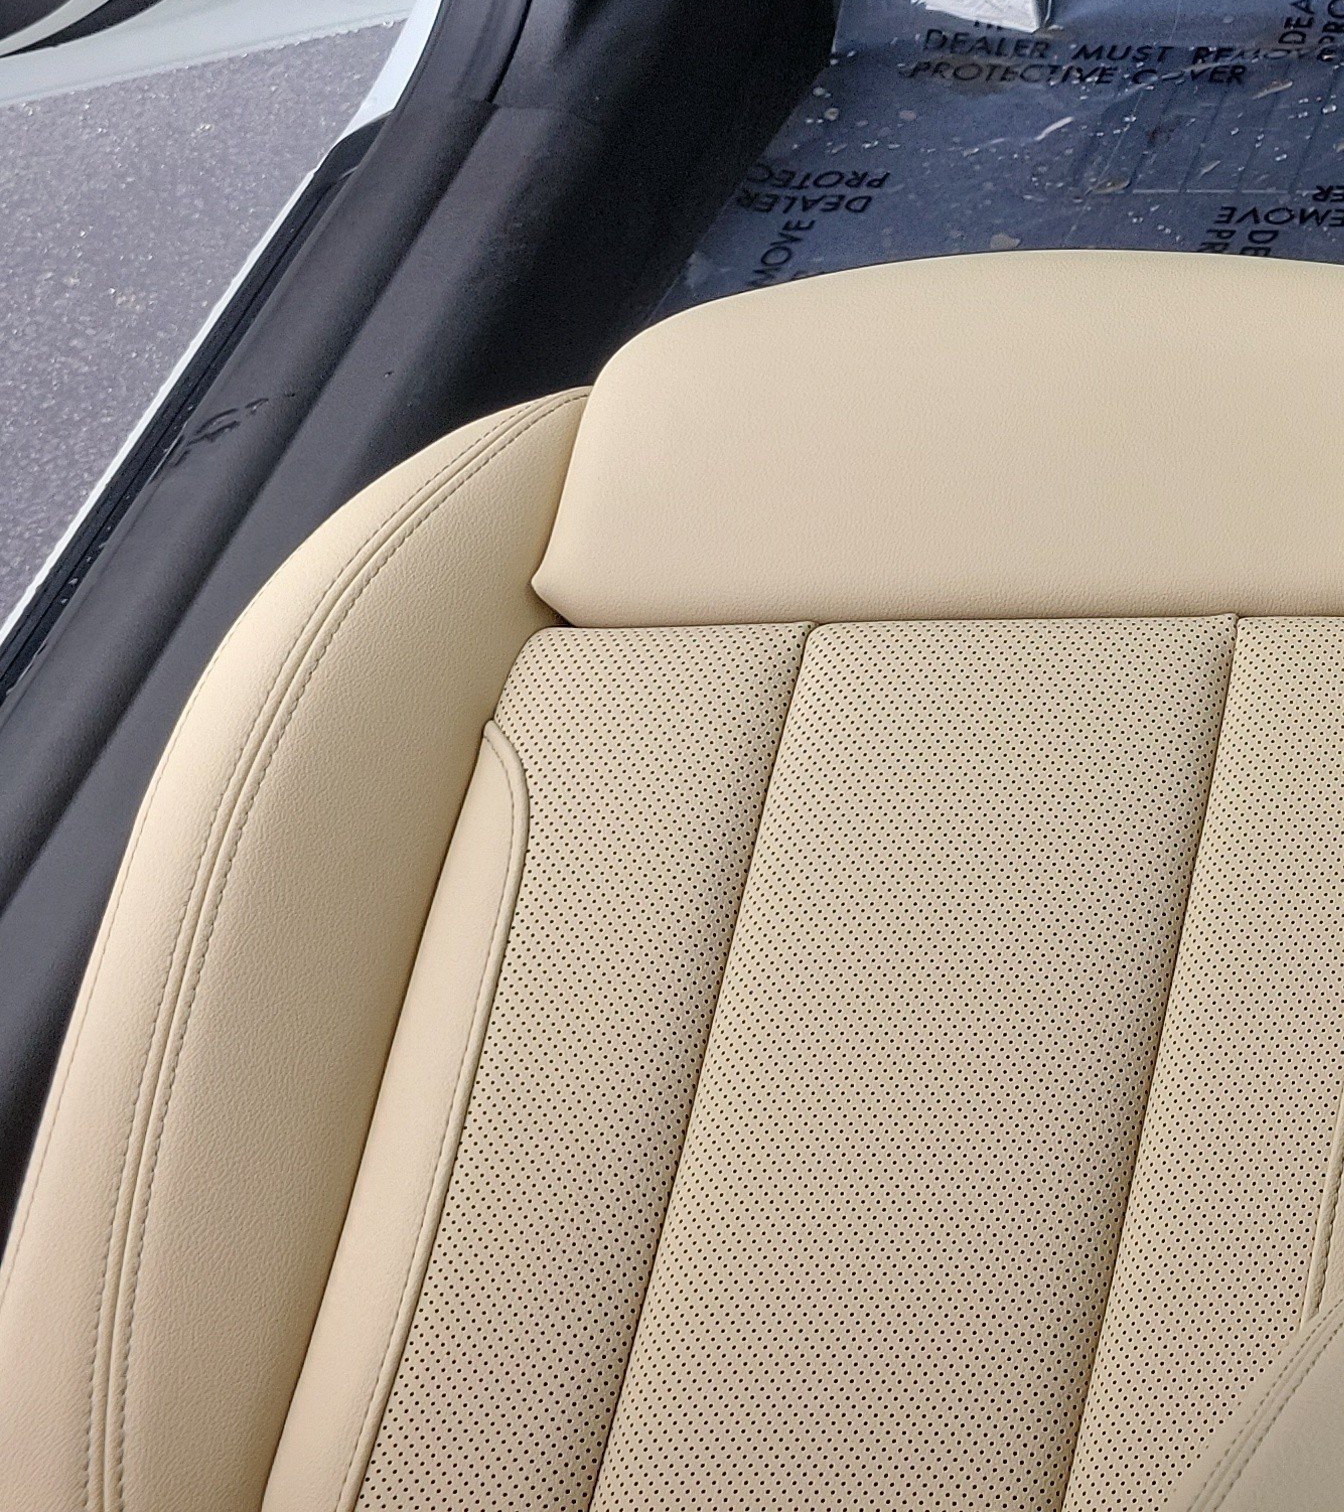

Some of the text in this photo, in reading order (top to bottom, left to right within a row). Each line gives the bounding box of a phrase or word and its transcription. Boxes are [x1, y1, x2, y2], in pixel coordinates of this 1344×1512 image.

[924, 28, 1050, 60] DEALER
[1072, 44, 1174, 64] MUST
[902, 62, 1117, 85] PROTECTIVE
